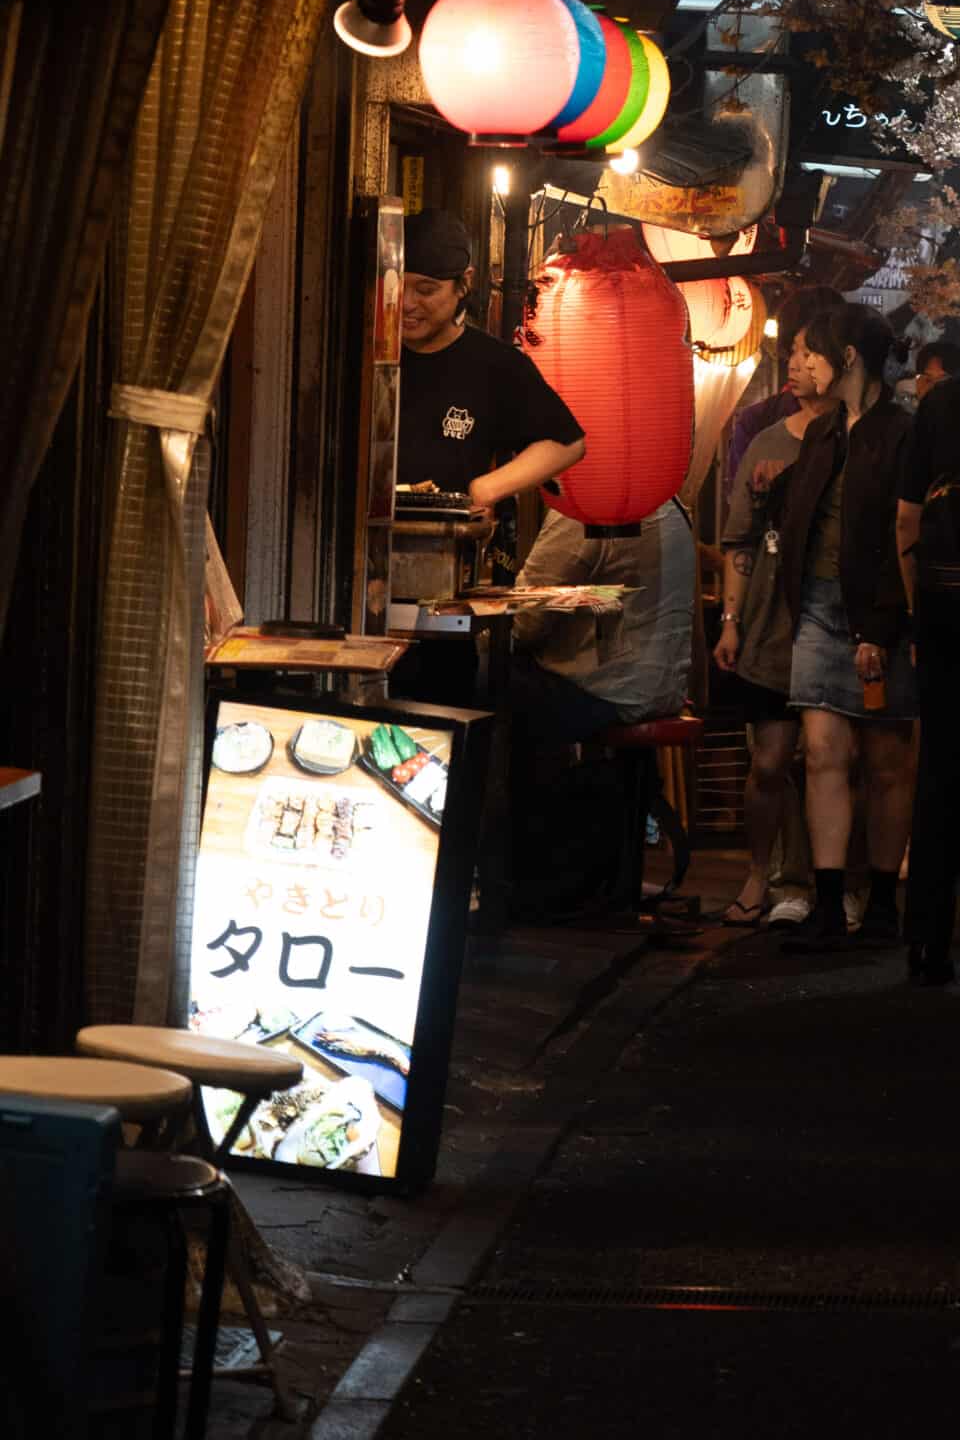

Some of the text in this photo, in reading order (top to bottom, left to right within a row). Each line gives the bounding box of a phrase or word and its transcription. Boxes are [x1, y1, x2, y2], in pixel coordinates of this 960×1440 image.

[243, 877, 386, 927] やきとり
[206, 919, 405, 990] タロー
